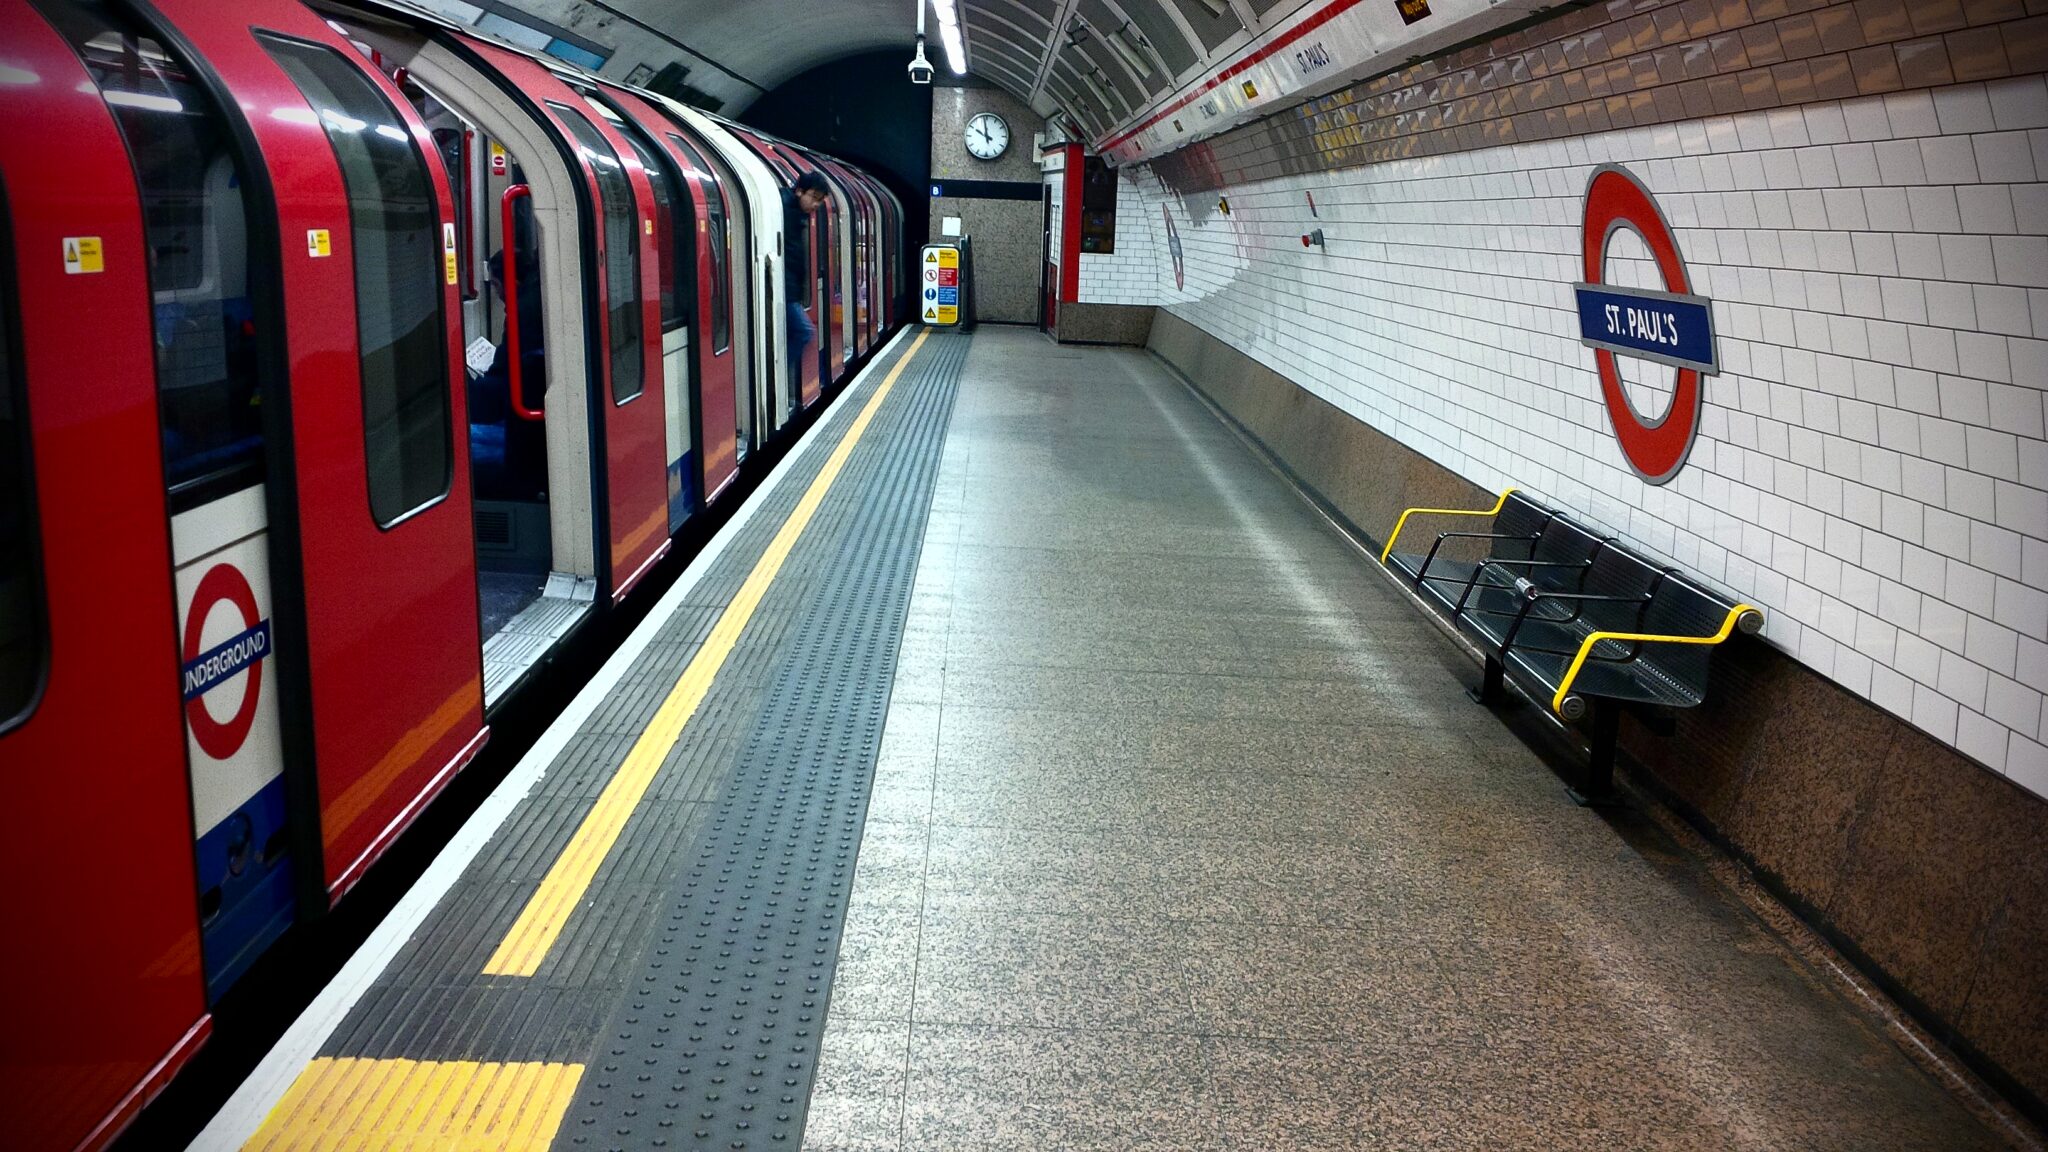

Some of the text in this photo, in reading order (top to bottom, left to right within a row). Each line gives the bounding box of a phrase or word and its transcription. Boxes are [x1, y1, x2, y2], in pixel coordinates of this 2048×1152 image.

[932, 186, 939, 195] B
[1605, 303, 1678, 346] ST. PAUL'S
